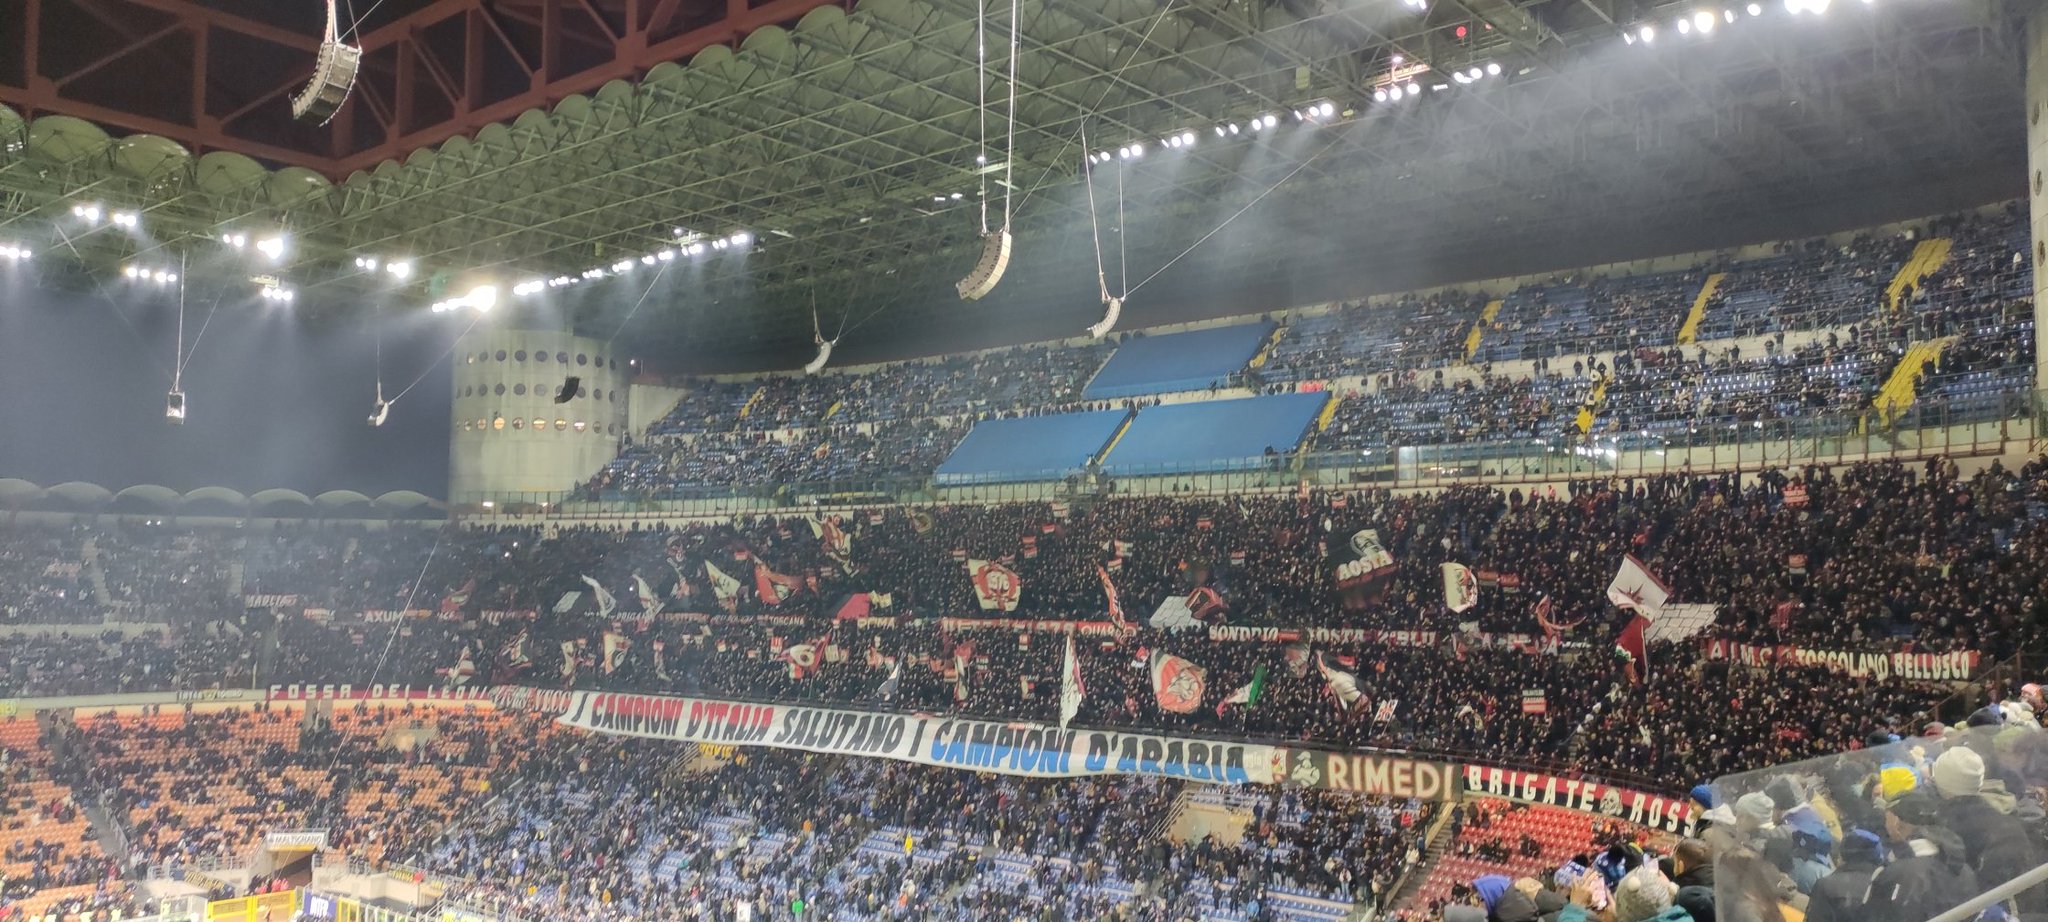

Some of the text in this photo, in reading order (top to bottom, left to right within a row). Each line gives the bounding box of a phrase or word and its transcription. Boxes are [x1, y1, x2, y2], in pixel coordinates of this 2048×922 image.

[1894, 650, 1970, 680] BELLUSCO
[270, 684, 352, 699] FOSSA
[372, 683, 411, 699] DEI
[427, 684, 486, 699] LEONI
[590, 693, 684, 736] CAMPIONI
[685, 700, 775, 742] D'ITALIA
[773, 708, 906, 754] SALUTANO
[908, 719, 928, 757] I
[931, 720, 1077, 773] CAMPIONI
[1085, 733, 1249, 784] D'ARABIA
[1328, 752, 1455, 800] RIMEDI
[1468, 765, 1699, 839] BRIGATE ROSS
